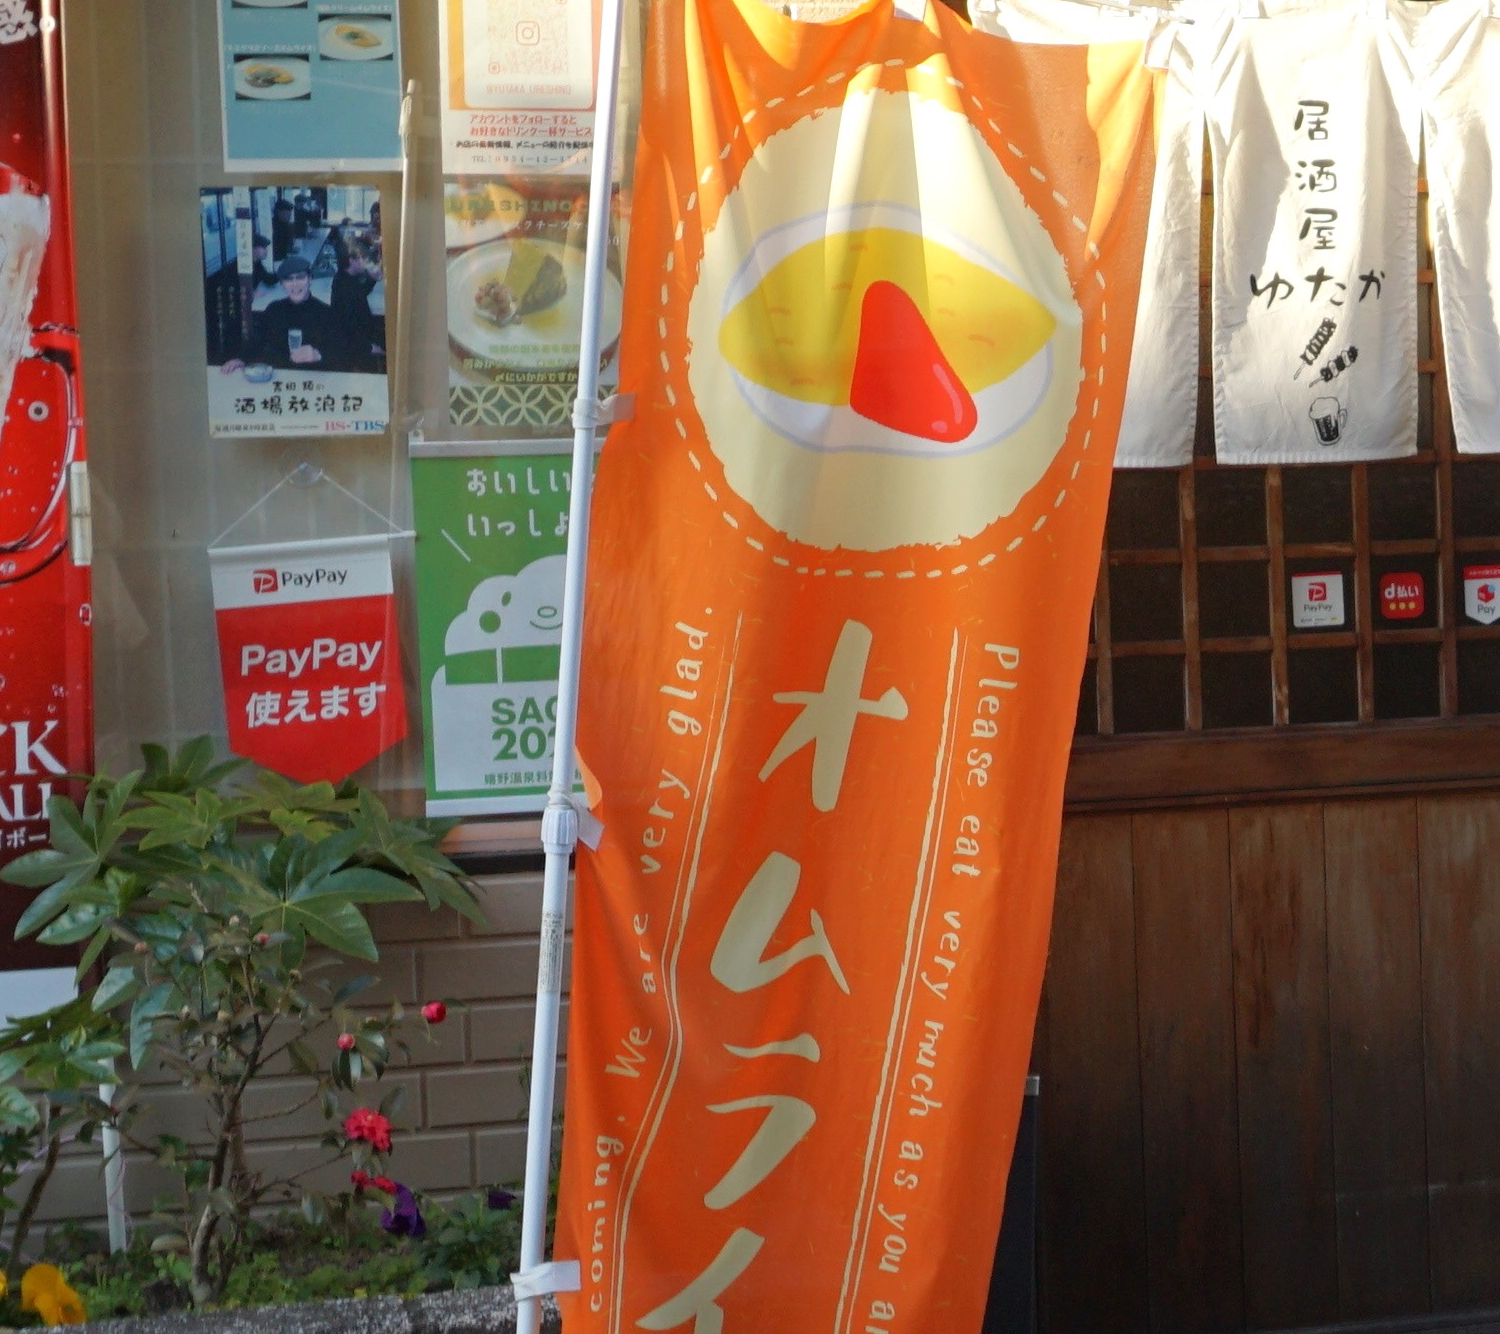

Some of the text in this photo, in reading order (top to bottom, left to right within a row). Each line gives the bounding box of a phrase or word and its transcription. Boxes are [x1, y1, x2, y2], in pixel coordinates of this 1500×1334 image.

[1294, 99, 1338, 251] 居酒屋
[1250, 266, 1386, 310] ゆたか
[234, 394, 364, 416] 酒場放浪記
[466, 467, 596, 497] おいしい
[281, 566, 348, 589] PayPay
[1477, 604, 1496, 615] Pay
[241, 637, 383, 678] PayPay
[660, 607, 714, 737] glad.
[245, 682, 387, 729] 使えます
[965, 641, 1021, 788] Please
[640, 768, 692, 876] very
[952, 815, 983, 878] eat
[632, 911, 658, 994] are
[920, 911, 963, 1001] very
[604, 1026, 653, 1080] We
[909, 1019, 945, 1118] much
[891, 1139, 924, 1191] as
[877, 1202, 909, 1275] you
